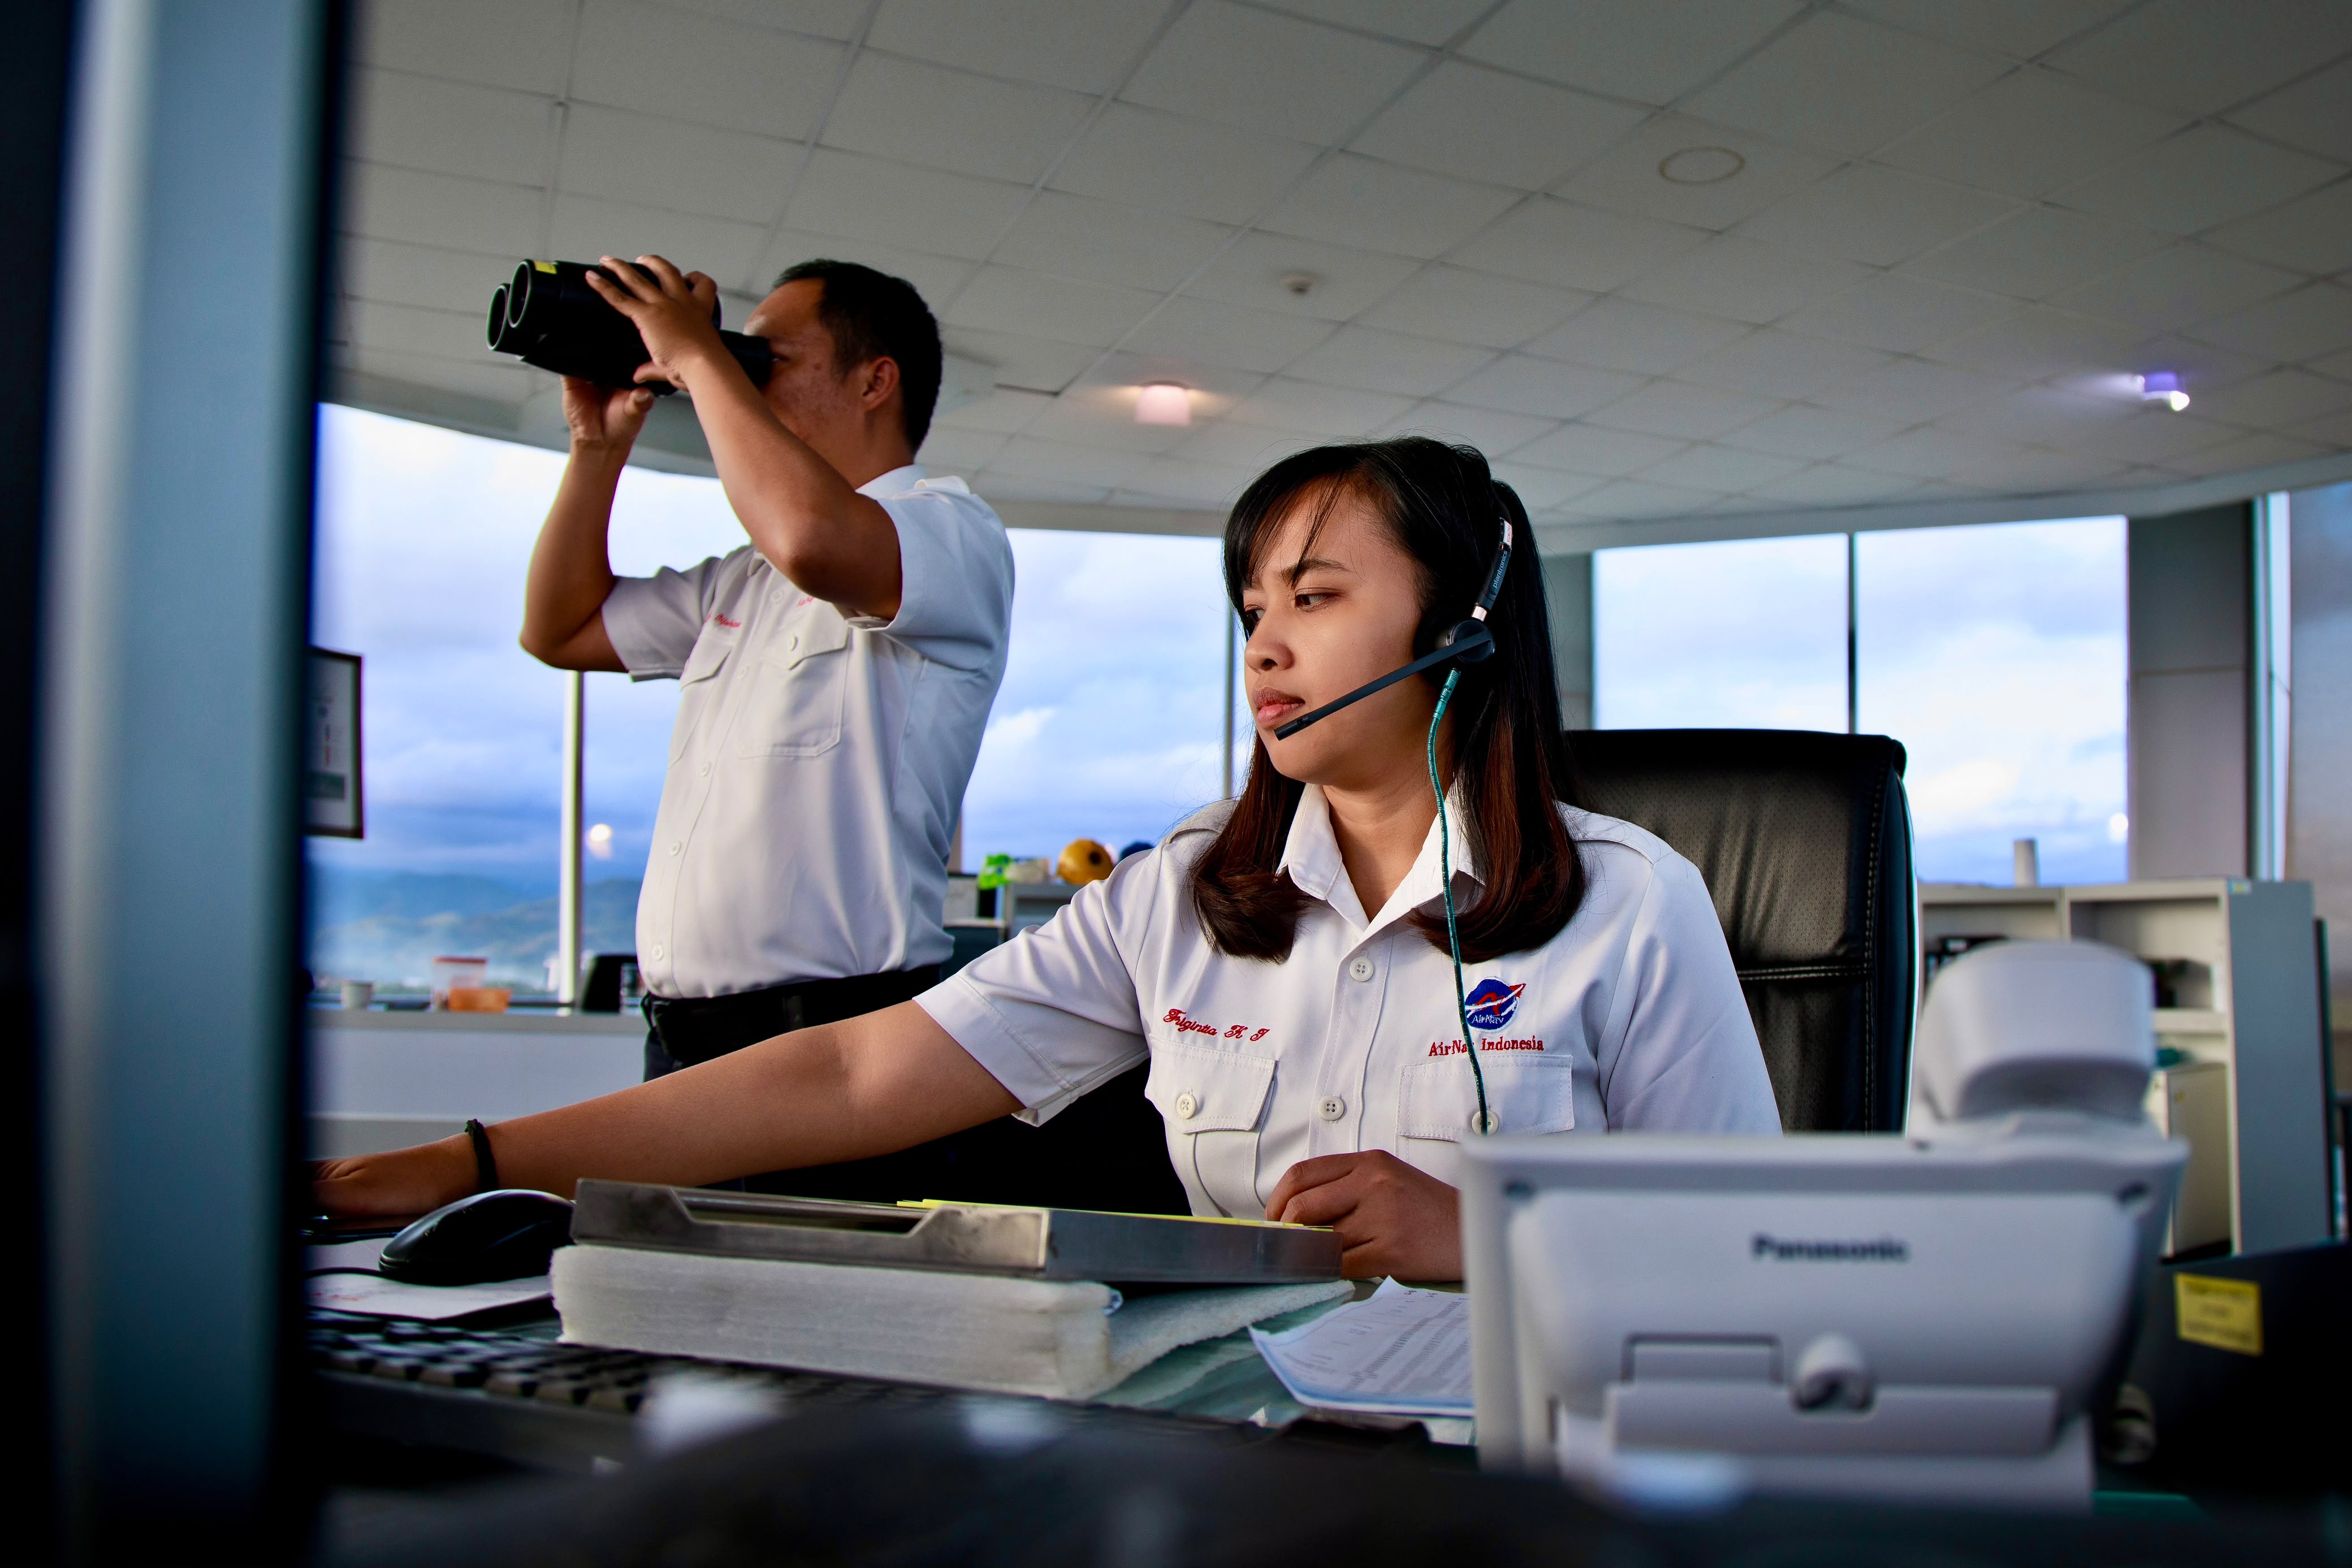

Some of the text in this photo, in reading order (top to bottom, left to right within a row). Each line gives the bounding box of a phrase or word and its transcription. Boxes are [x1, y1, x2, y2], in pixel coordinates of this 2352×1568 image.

[1493, 551, 1508, 589] plantronics
[1224, 1025, 1248, 1039] K
[1428, 1035, 1544, 1056] AirNa Indonesia
[1752, 1233, 1910, 1263] Panasonic
